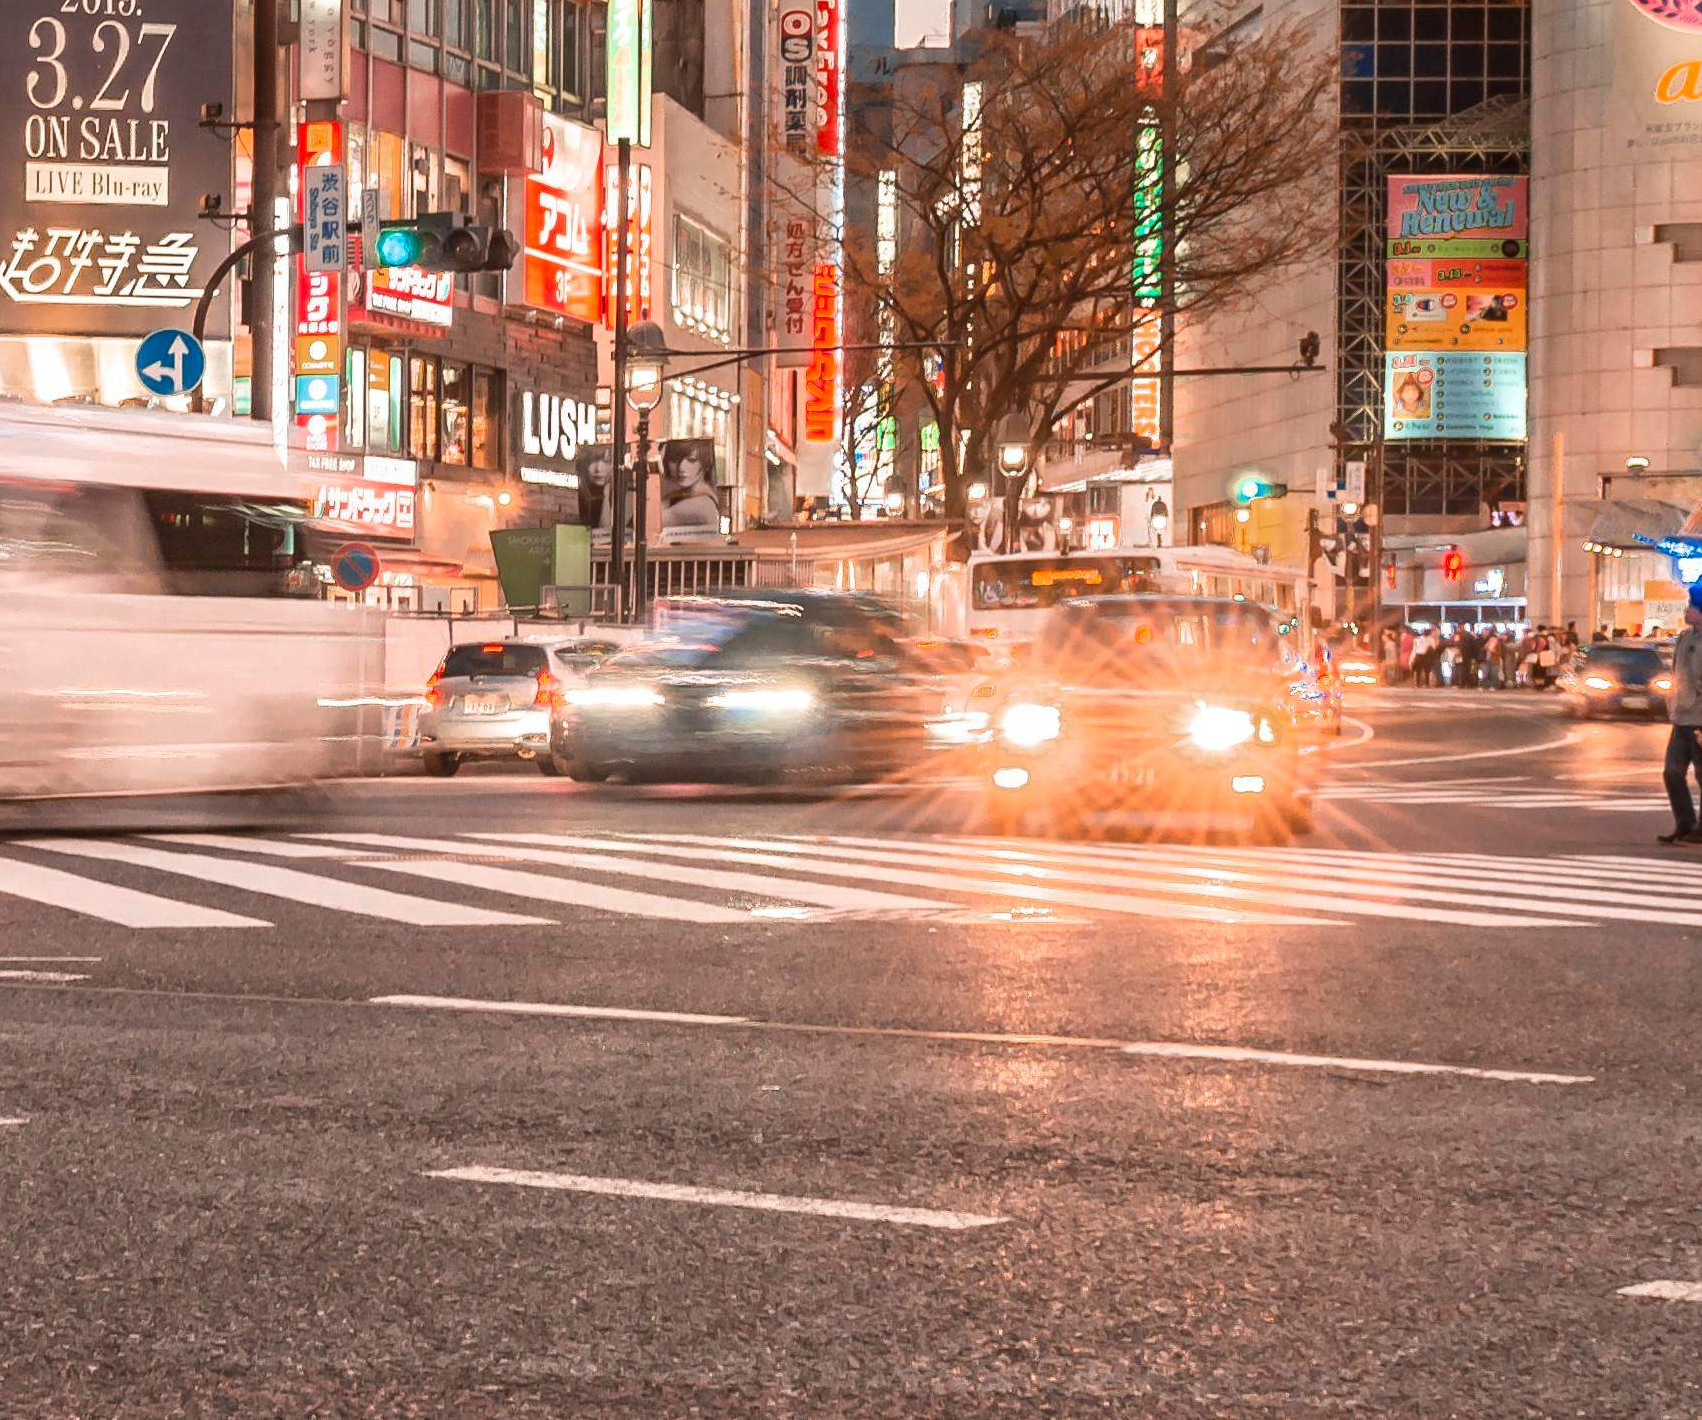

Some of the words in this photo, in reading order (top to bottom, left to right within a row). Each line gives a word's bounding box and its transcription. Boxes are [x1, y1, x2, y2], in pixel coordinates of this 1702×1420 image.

[25, 16, 178, 115] 3.27
[782, 11, 813, 62] OS
[24, 115, 69, 160] ON
[79, 117, 171, 162] SALE
[35, 169, 85, 196] LIVE
[91, 170, 163, 202] Blu-ray
[321, 172, 341, 265] 渋谷駅前
[538, 192, 589, 257] アコム
[785, 221, 805, 336] 処方せん受付
[521, 391, 596, 461] LUSH
